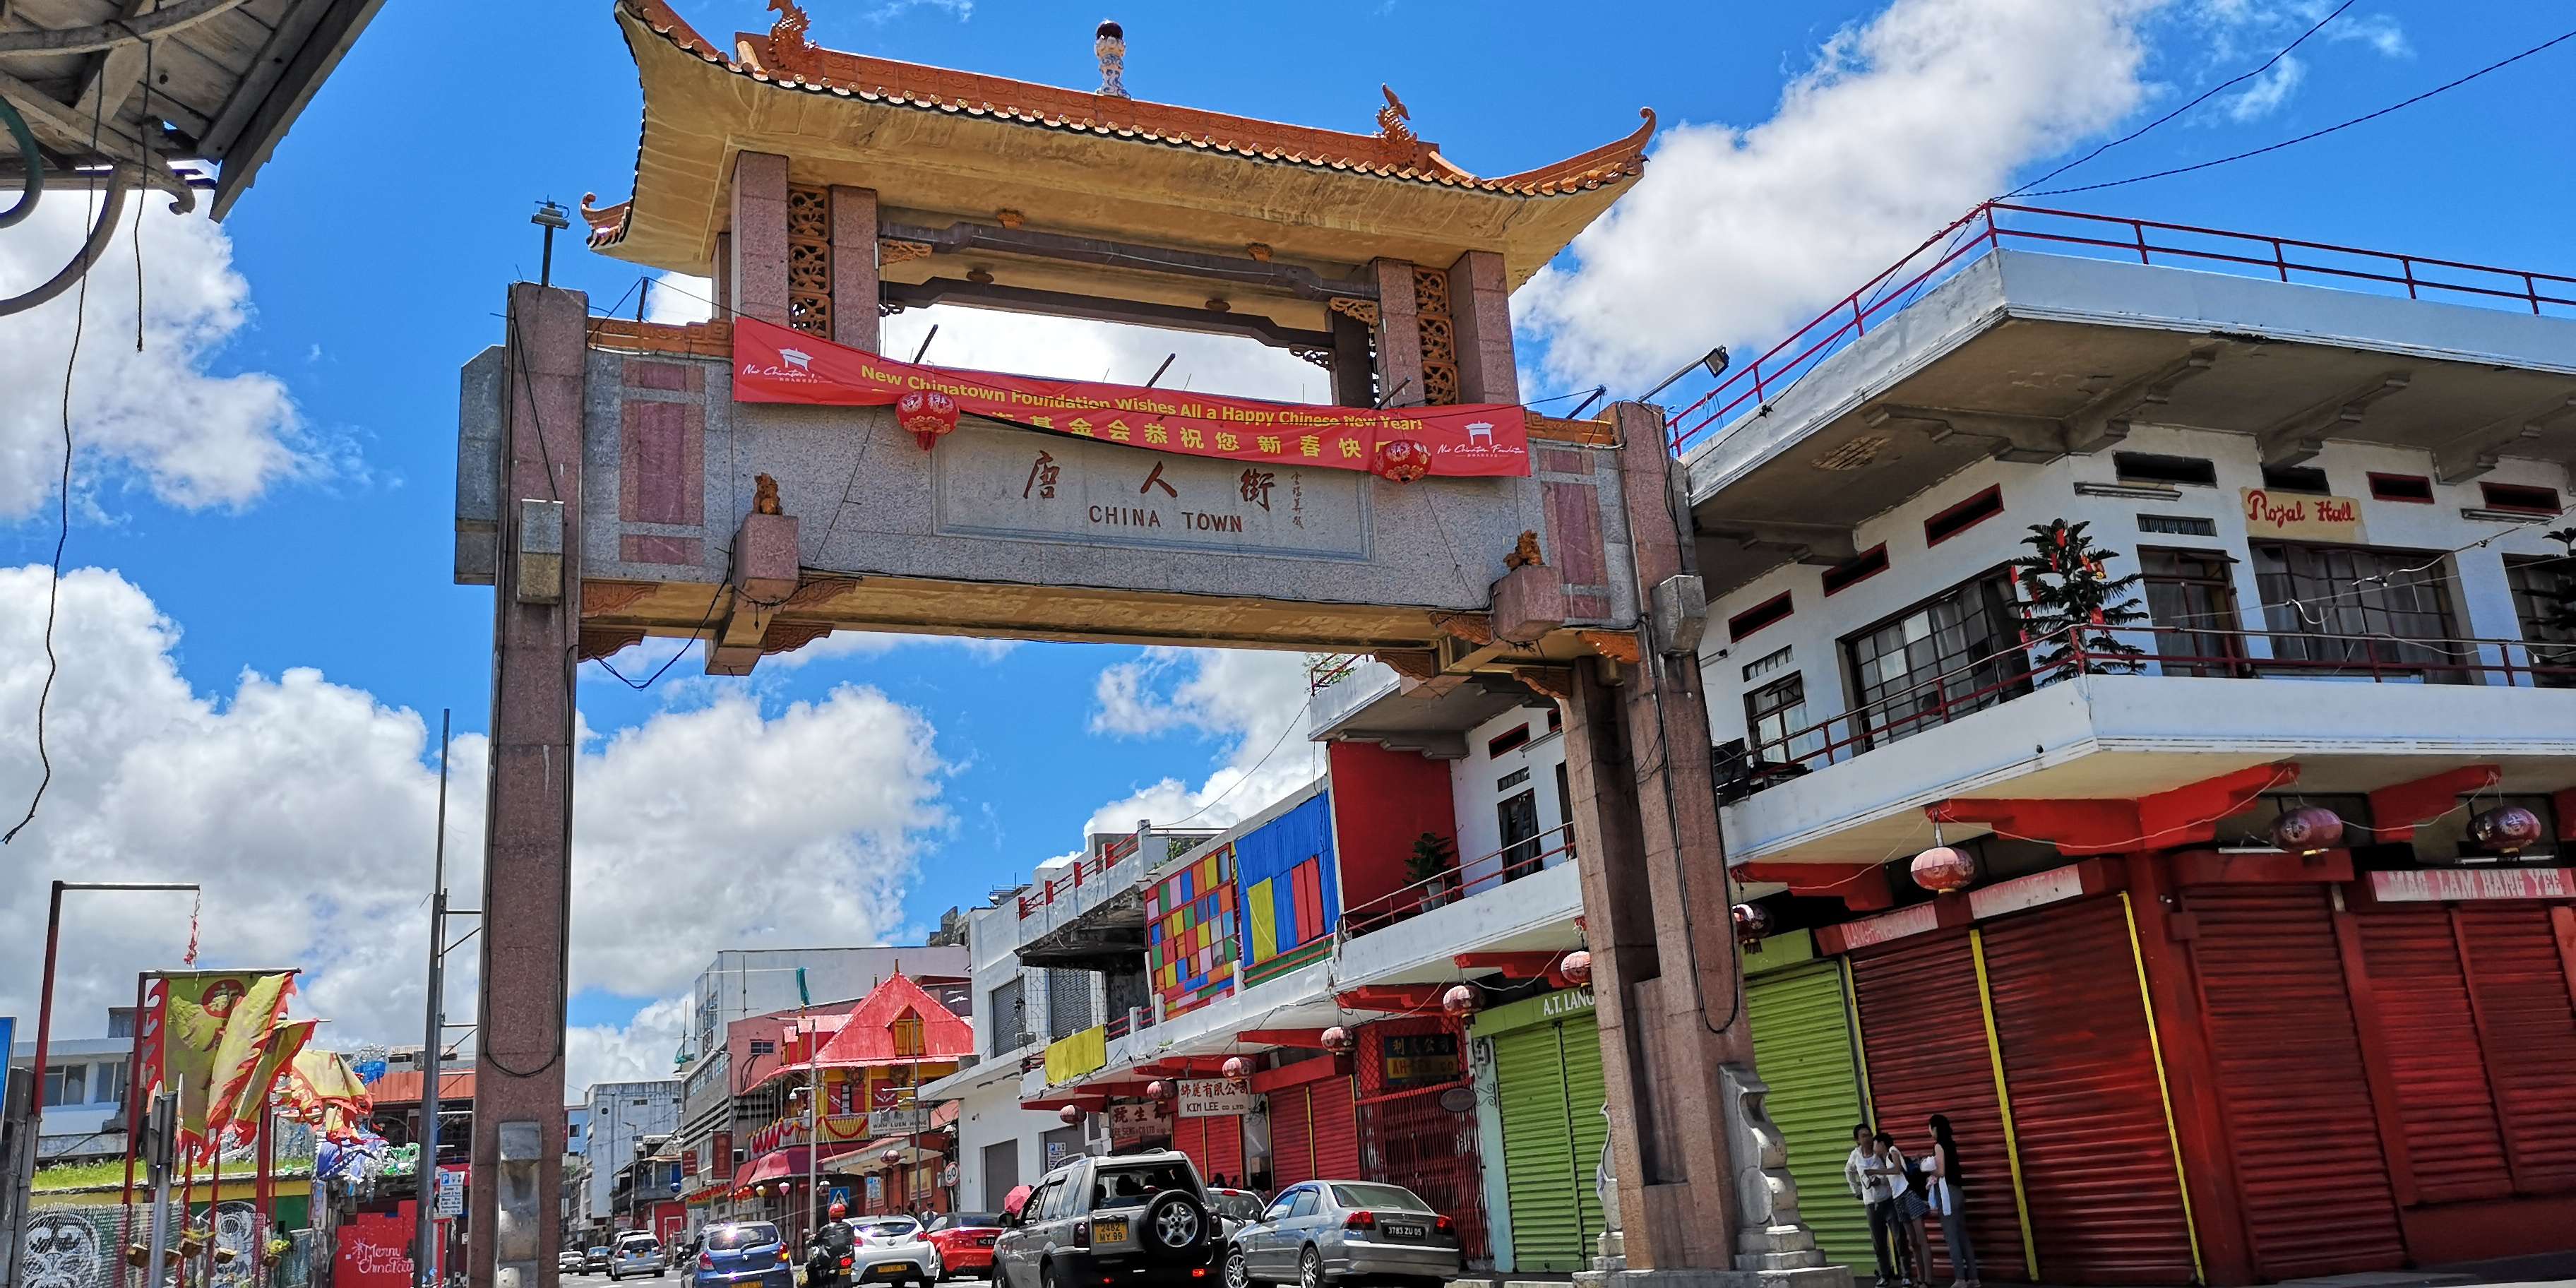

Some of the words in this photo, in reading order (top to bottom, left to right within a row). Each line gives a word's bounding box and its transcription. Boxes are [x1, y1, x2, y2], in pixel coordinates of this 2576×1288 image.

[861, 364, 902, 386] New
[907, 376, 1006, 402] Chinatown
[1011, 390, 1110, 410] Foundation
[1115, 398, 1176, 415] Wishes
[1180, 404, 1202, 419] All
[1207, 408, 1217, 419] a
[1222, 407, 1275, 427] Happy
[1280, 411, 1340, 427] Chinese
[1343, 415, 1376, 427] New
[1379, 415, 1423, 430] Year!
[1088, 505, 1162, 528] CHINA
[1181, 511, 1244, 533] TOWN
[2248, 489, 2305, 529] Royal
[2314, 500, 2355, 522] Hall
[2436, 871, 2478, 898] LAM
[2479, 869, 2526, 898] HANG
[2527, 869, 2565, 896] YEE
[1543, 996, 1563, 1017] A.T.
[1392, 1037, 1449, 1055] 利公司
[1186, 1102, 1201, 1112] KIM
[1204, 1102, 1219, 1111] LEE
[947, 1167, 956, 1180] 60
